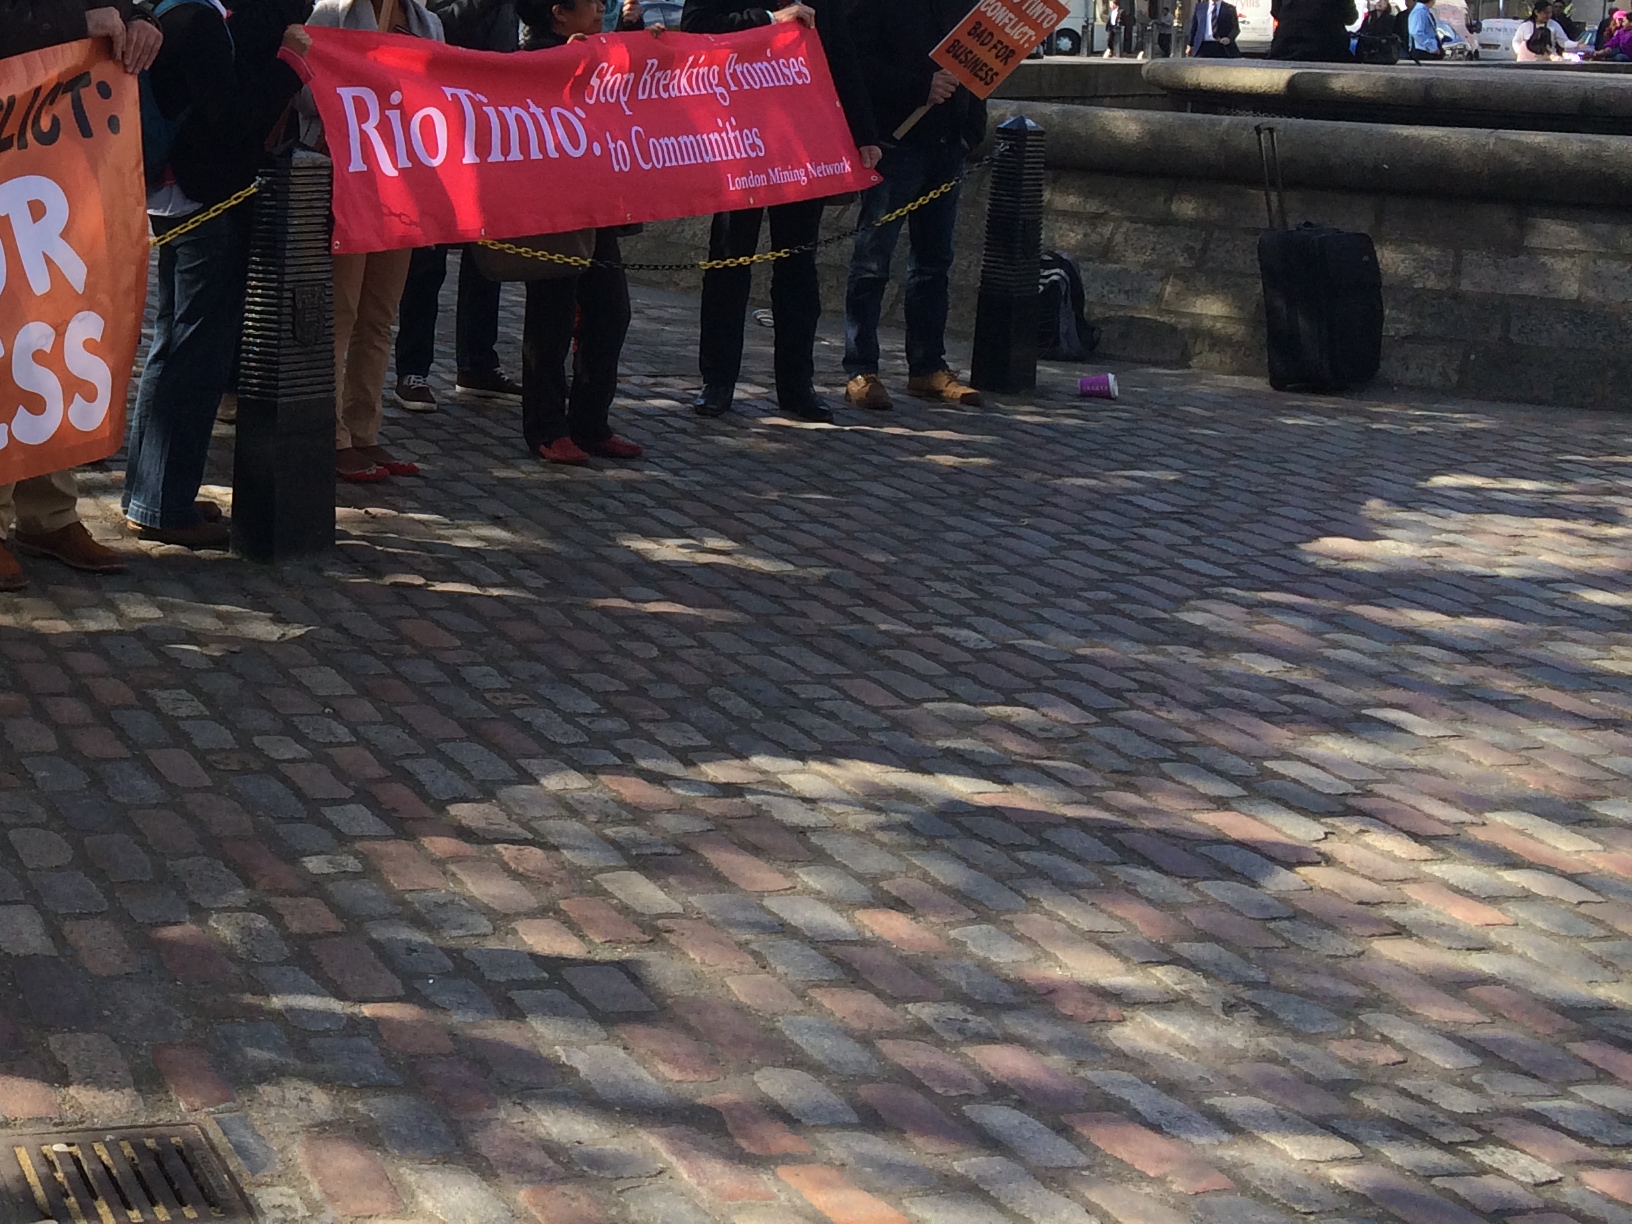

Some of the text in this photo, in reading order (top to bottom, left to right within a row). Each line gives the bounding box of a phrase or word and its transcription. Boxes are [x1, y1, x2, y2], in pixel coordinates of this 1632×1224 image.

[945, 38, 1000, 87] BUSINESS
[967, 20, 1016, 66] BAD FOR
[583, 48, 812, 116] Stop Breaking Promises
[336, 85, 447, 178] Rio
[608, 113, 766, 174] to Communities
[727, 155, 852, 191] London Mining Network
